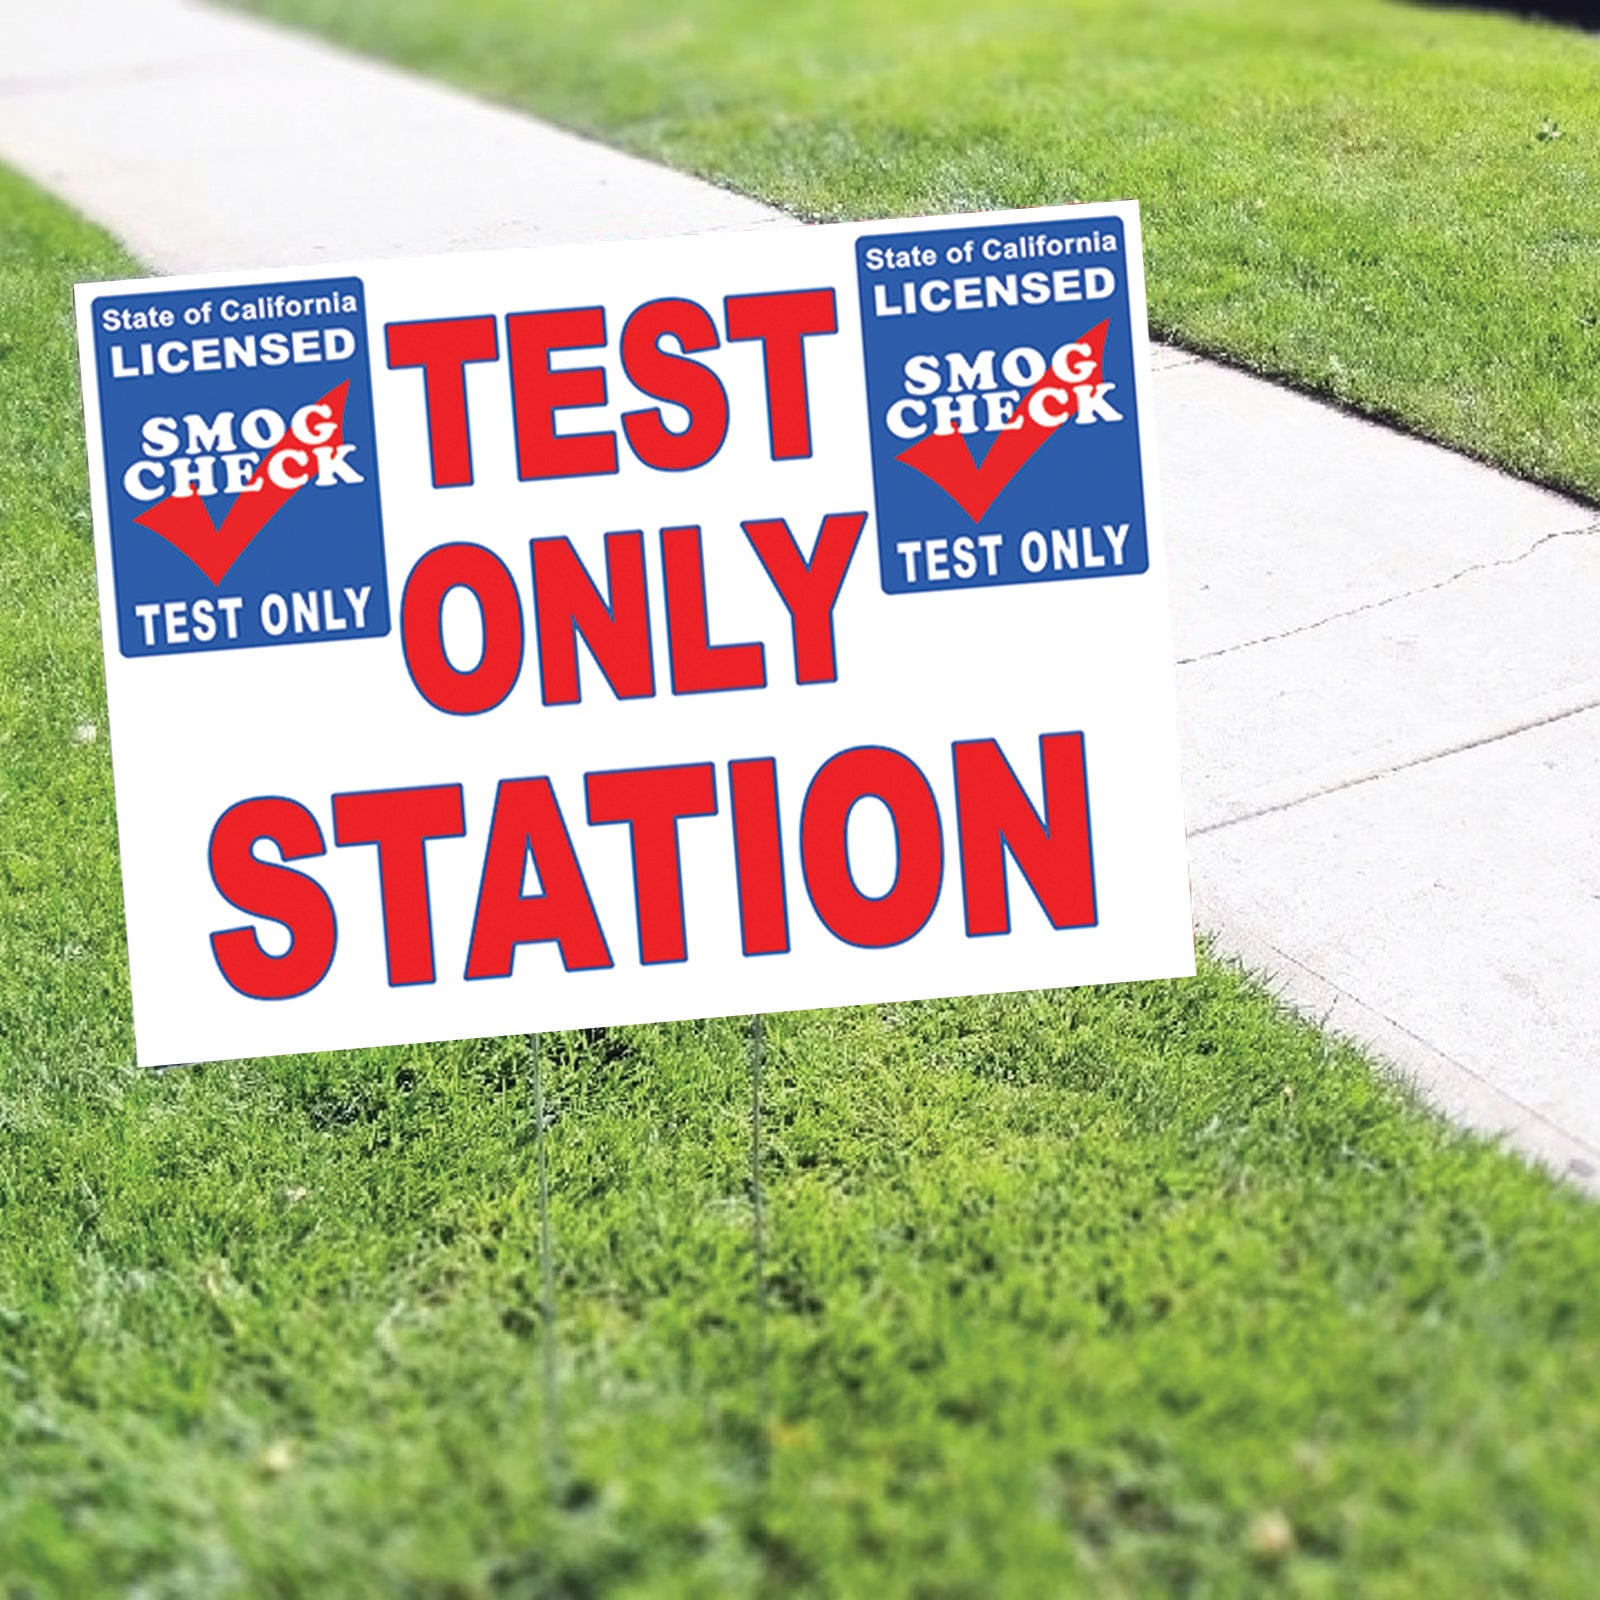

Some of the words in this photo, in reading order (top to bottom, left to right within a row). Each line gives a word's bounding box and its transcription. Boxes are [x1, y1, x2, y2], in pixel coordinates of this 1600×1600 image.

[866, 248, 937, 270] State
[946, 240, 974, 264] of
[982, 231, 1117, 261] California
[102, 309, 175, 332] State
[183, 301, 212, 325] of
[220, 292, 358, 322] California
[874, 267, 1115, 317] LICENSED
[111, 328, 356, 378] LICENSED
[904, 343, 1097, 396] SMOG
[386, 290, 836, 487] TEST
[886, 382, 1124, 439] CHECK
[142, 404, 338, 458] SMOG
[124, 444, 365, 501] CHECK
[896, 534, 1003, 583] TEST
[1021, 524, 1129, 573] ONLY
[135, 597, 243, 646] TEST
[260, 586, 371, 636] ONLY
[402, 514, 865, 714] ONLY
[210, 733, 1096, 998] STATION
